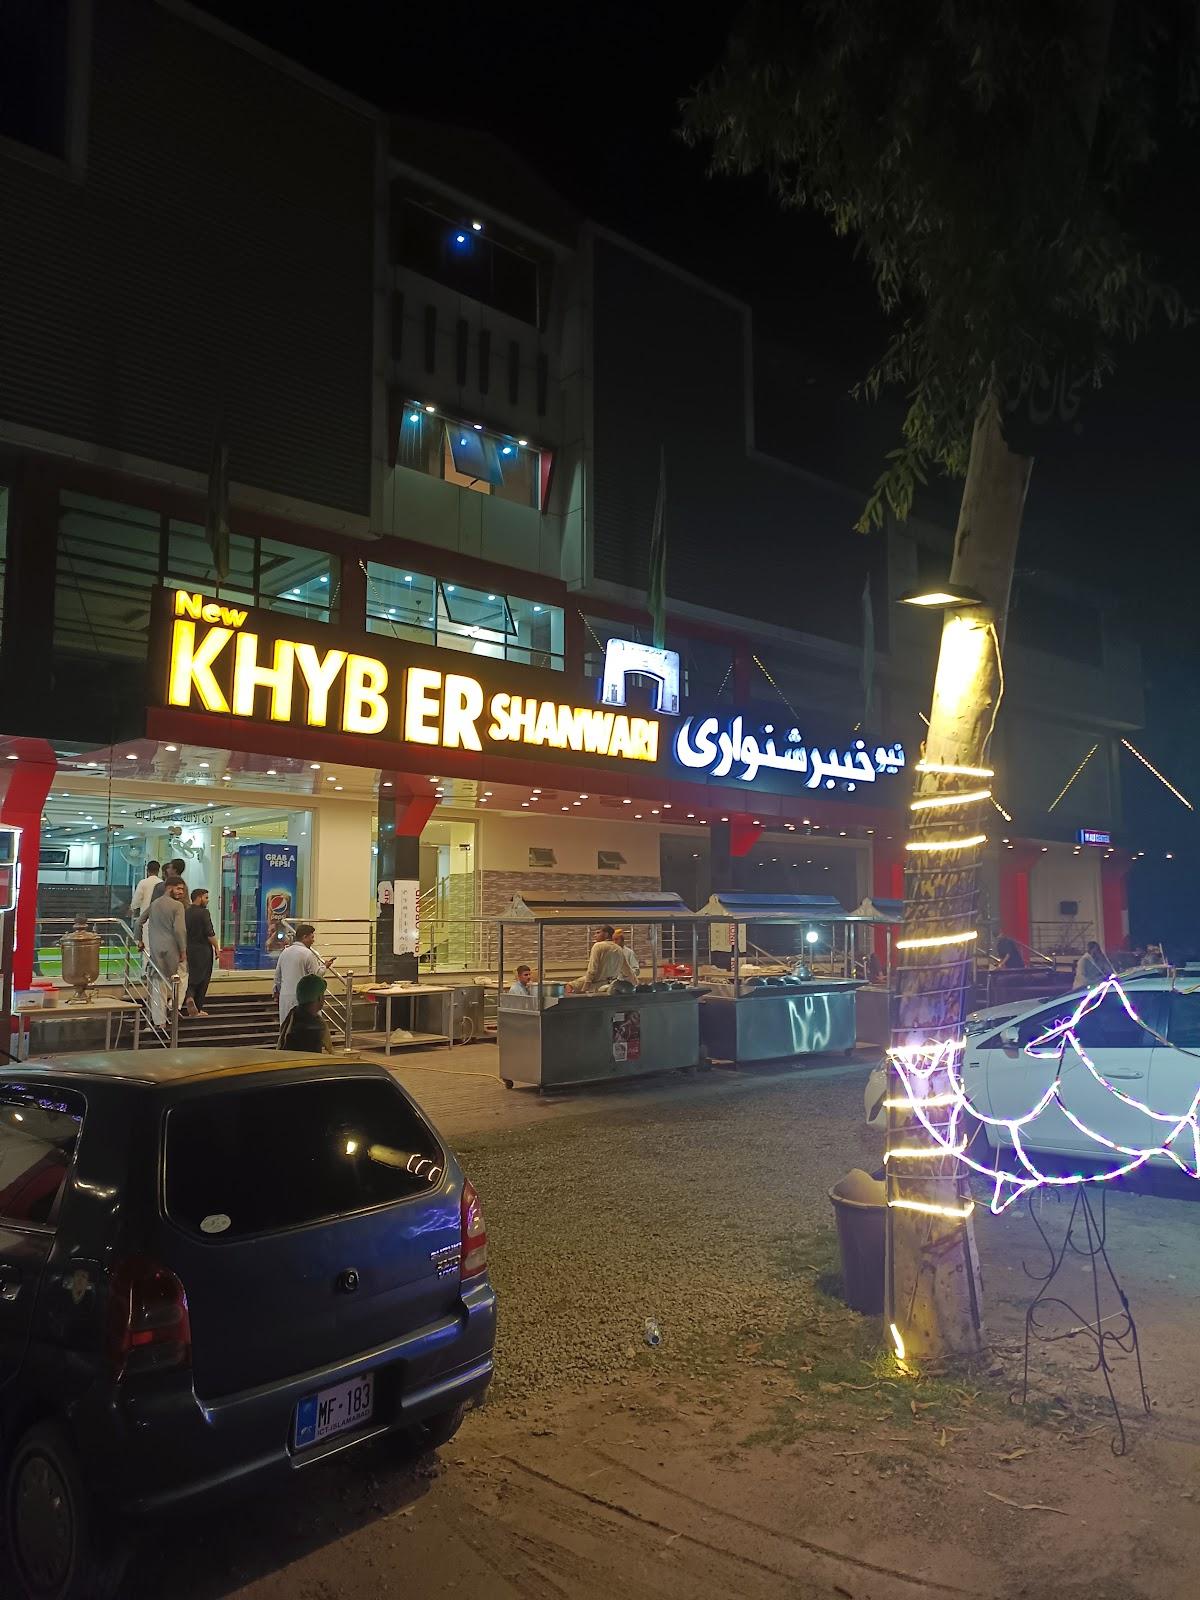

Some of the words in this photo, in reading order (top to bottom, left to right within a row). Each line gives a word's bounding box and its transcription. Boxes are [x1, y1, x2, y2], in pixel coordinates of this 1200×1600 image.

[174, 590, 249, 629] New
[488, 692, 659, 762] SHANWARI
[675, 715, 808, 782] شنواری
[265, 853, 288, 861] GRAB
[289, 854, 296, 862] A
[270, 860, 291, 868] PEPSI
[317, 1410, 371, 1436] ICT-ISLAMABAD
